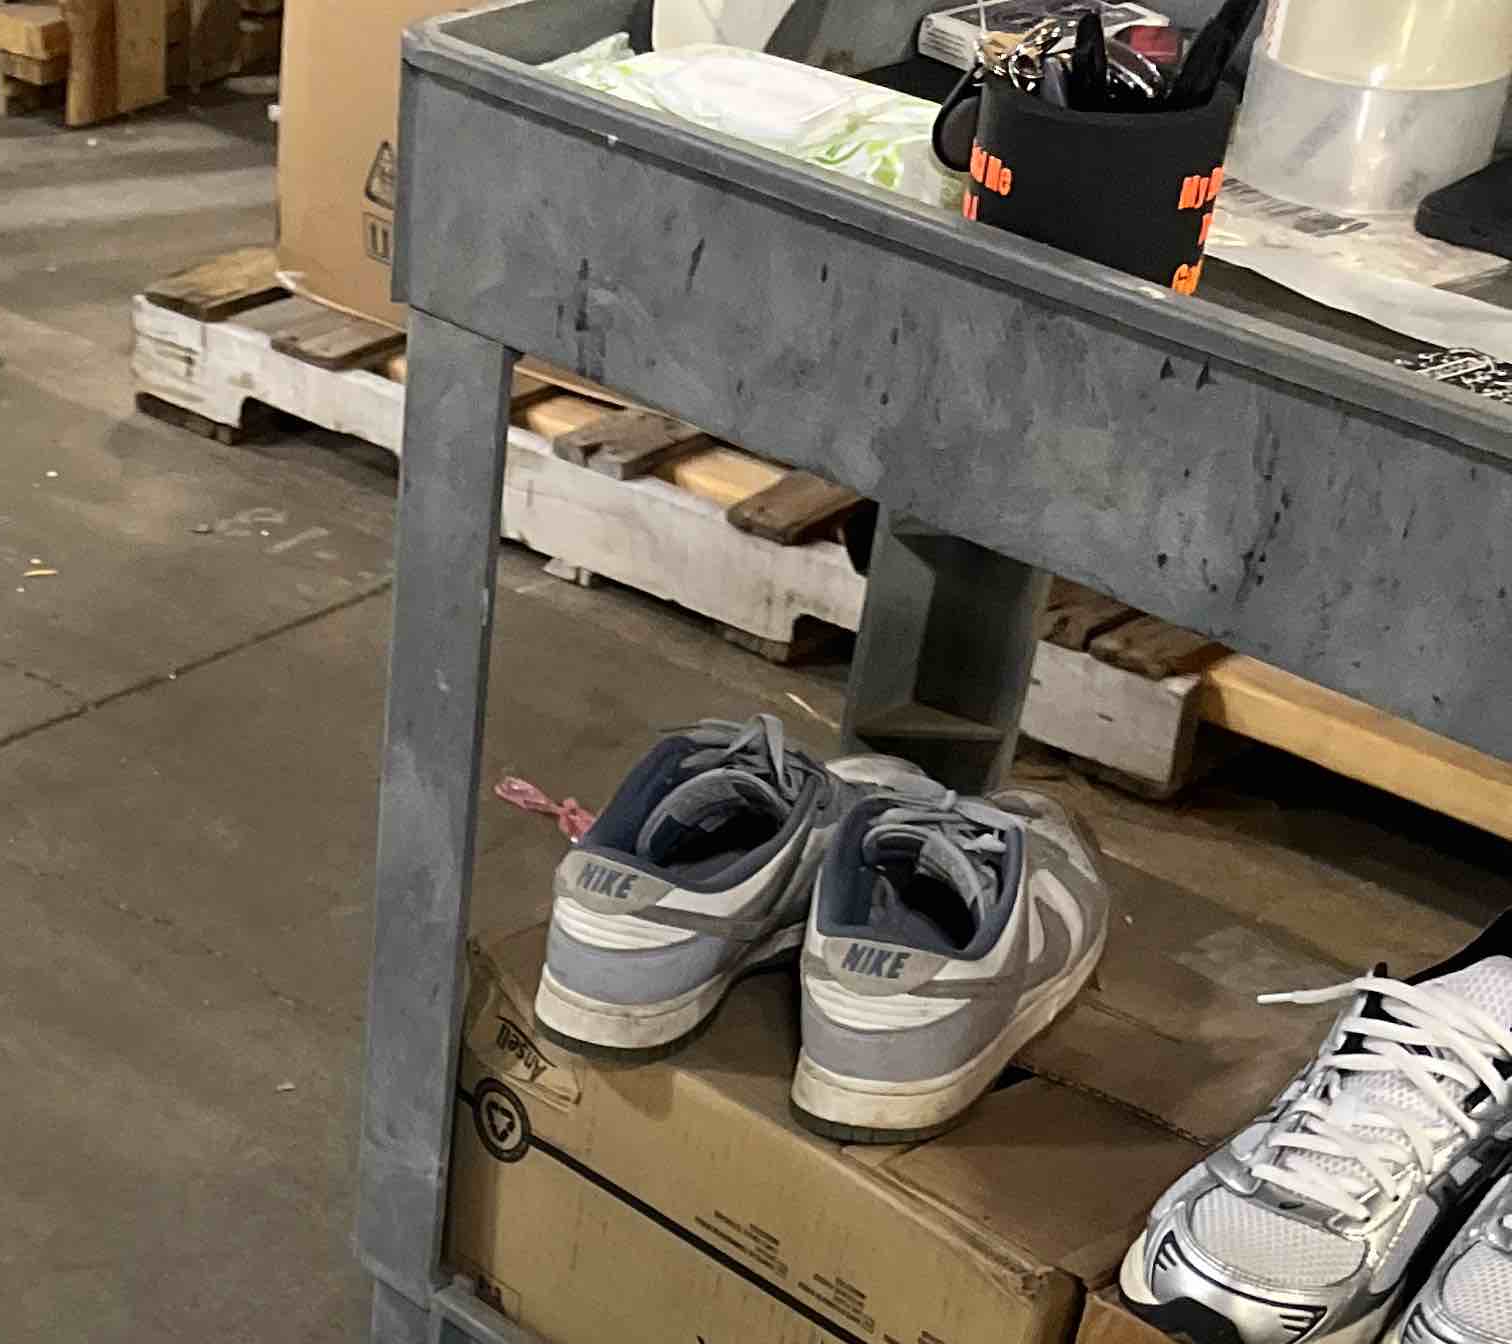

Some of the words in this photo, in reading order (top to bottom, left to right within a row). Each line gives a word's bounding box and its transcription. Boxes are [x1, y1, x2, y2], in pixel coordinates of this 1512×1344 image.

[576, 863, 638, 899] NIKE
[841, 943, 912, 978] NIKE
[496, 1023, 548, 1082] Ansell
